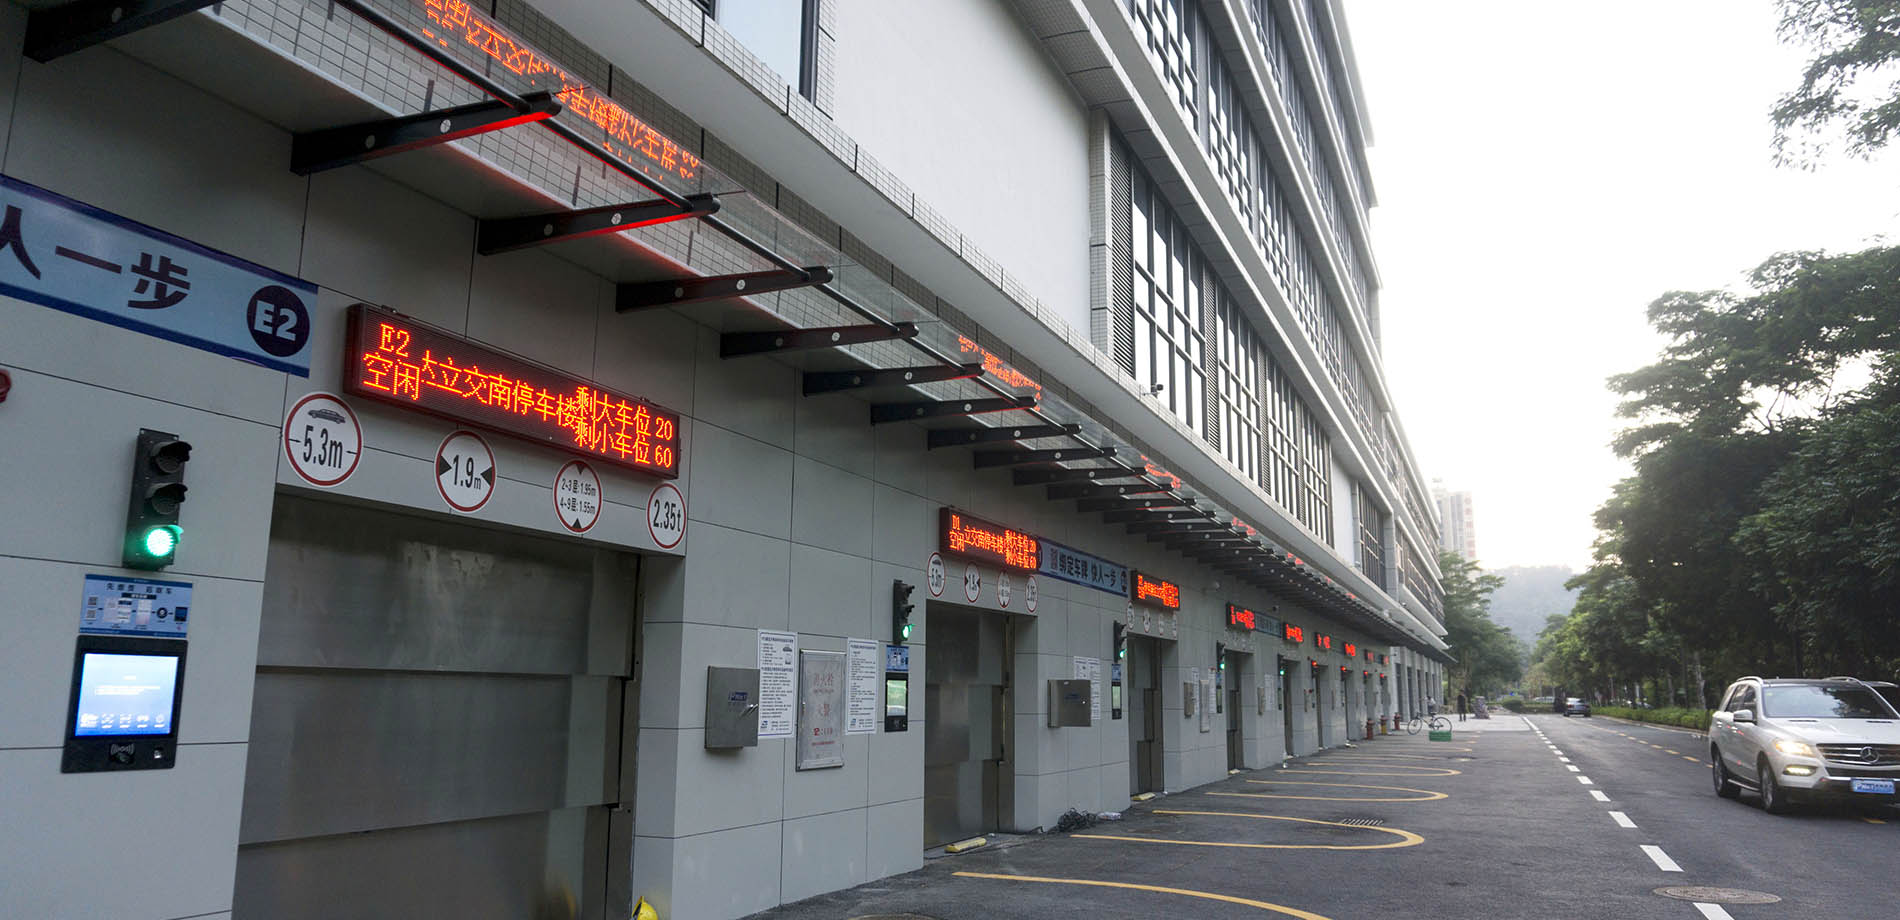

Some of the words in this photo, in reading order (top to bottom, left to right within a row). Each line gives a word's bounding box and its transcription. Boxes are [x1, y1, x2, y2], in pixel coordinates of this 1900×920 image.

[0, 203, 191, 310] 人一步
[253, 299, 299, 342] E2
[379, 322, 411, 358] E2
[362, 351, 420, 402] 空闲
[575, 385, 652, 437] 剩大车位
[655, 416, 673, 441] 20
[303, 424, 343, 469] 5.3m
[573, 416, 651, 465] 剩小车位
[654, 444, 673, 468] 60
[452, 454, 482, 490] 1.9m
[653, 498, 681, 532] 2.35t
